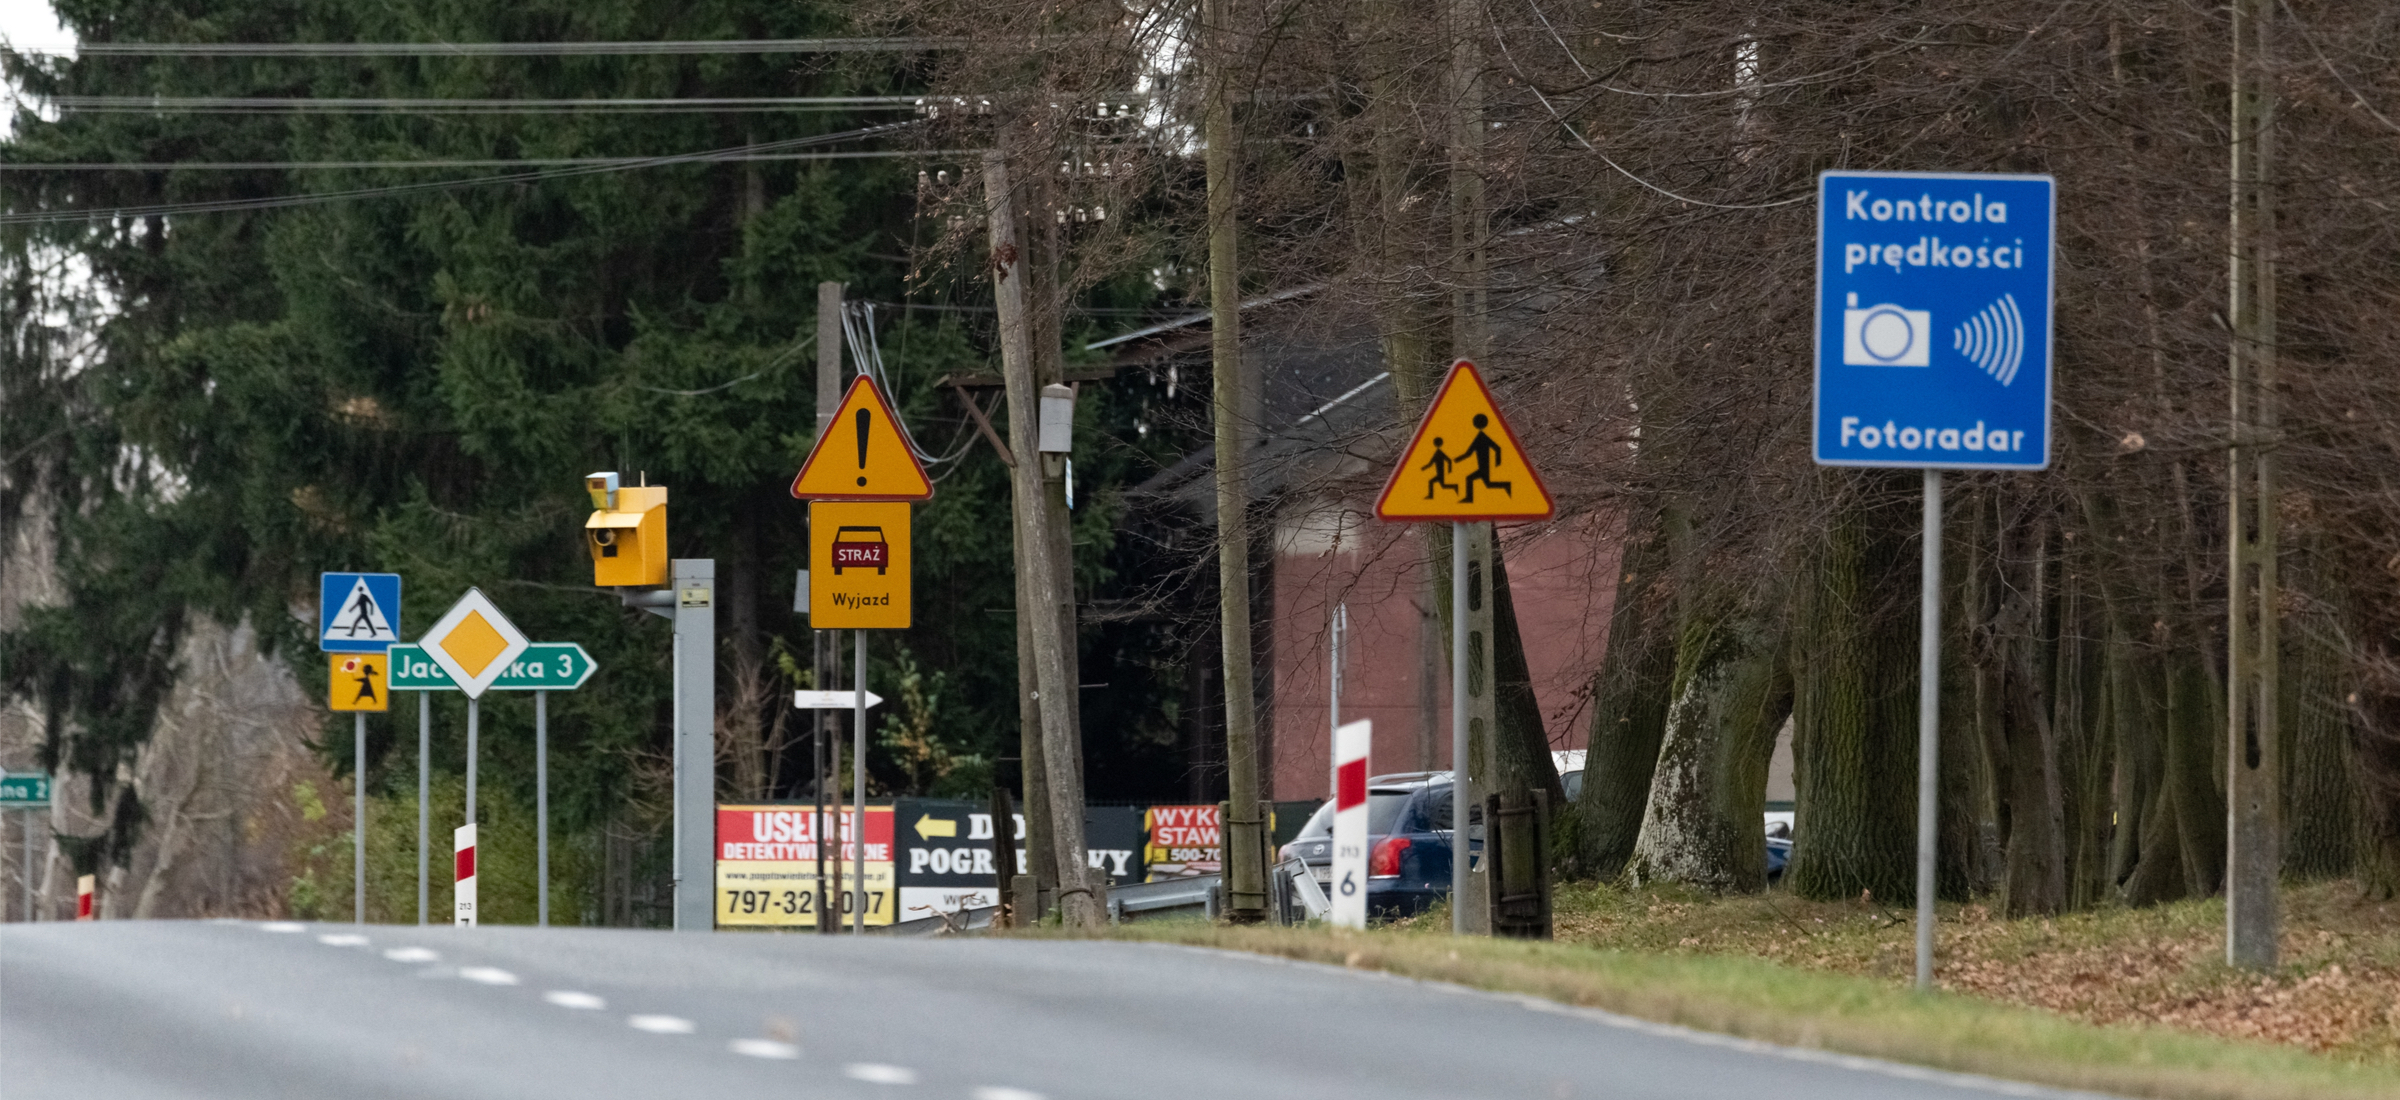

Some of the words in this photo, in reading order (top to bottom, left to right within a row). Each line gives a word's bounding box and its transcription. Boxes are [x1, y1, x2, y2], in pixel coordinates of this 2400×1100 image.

[1846, 190, 2007, 223] Kontrola
[1845, 236, 2023, 275] prędkości
[1840, 416, 2024, 452] Fotoradar
[838, 545, 880, 561] STRAŻ
[832, 592, 890, 610] Wyjazd
[397, 655, 545, 679] Jacka
[556, 654, 574, 678] 3
[35, 781, 47, 799] 2
[1158, 826, 1220, 845] STAW
[1340, 845, 1360, 858] 213
[1340, 870, 1357, 897] 6
[459, 902, 472, 911] 213
